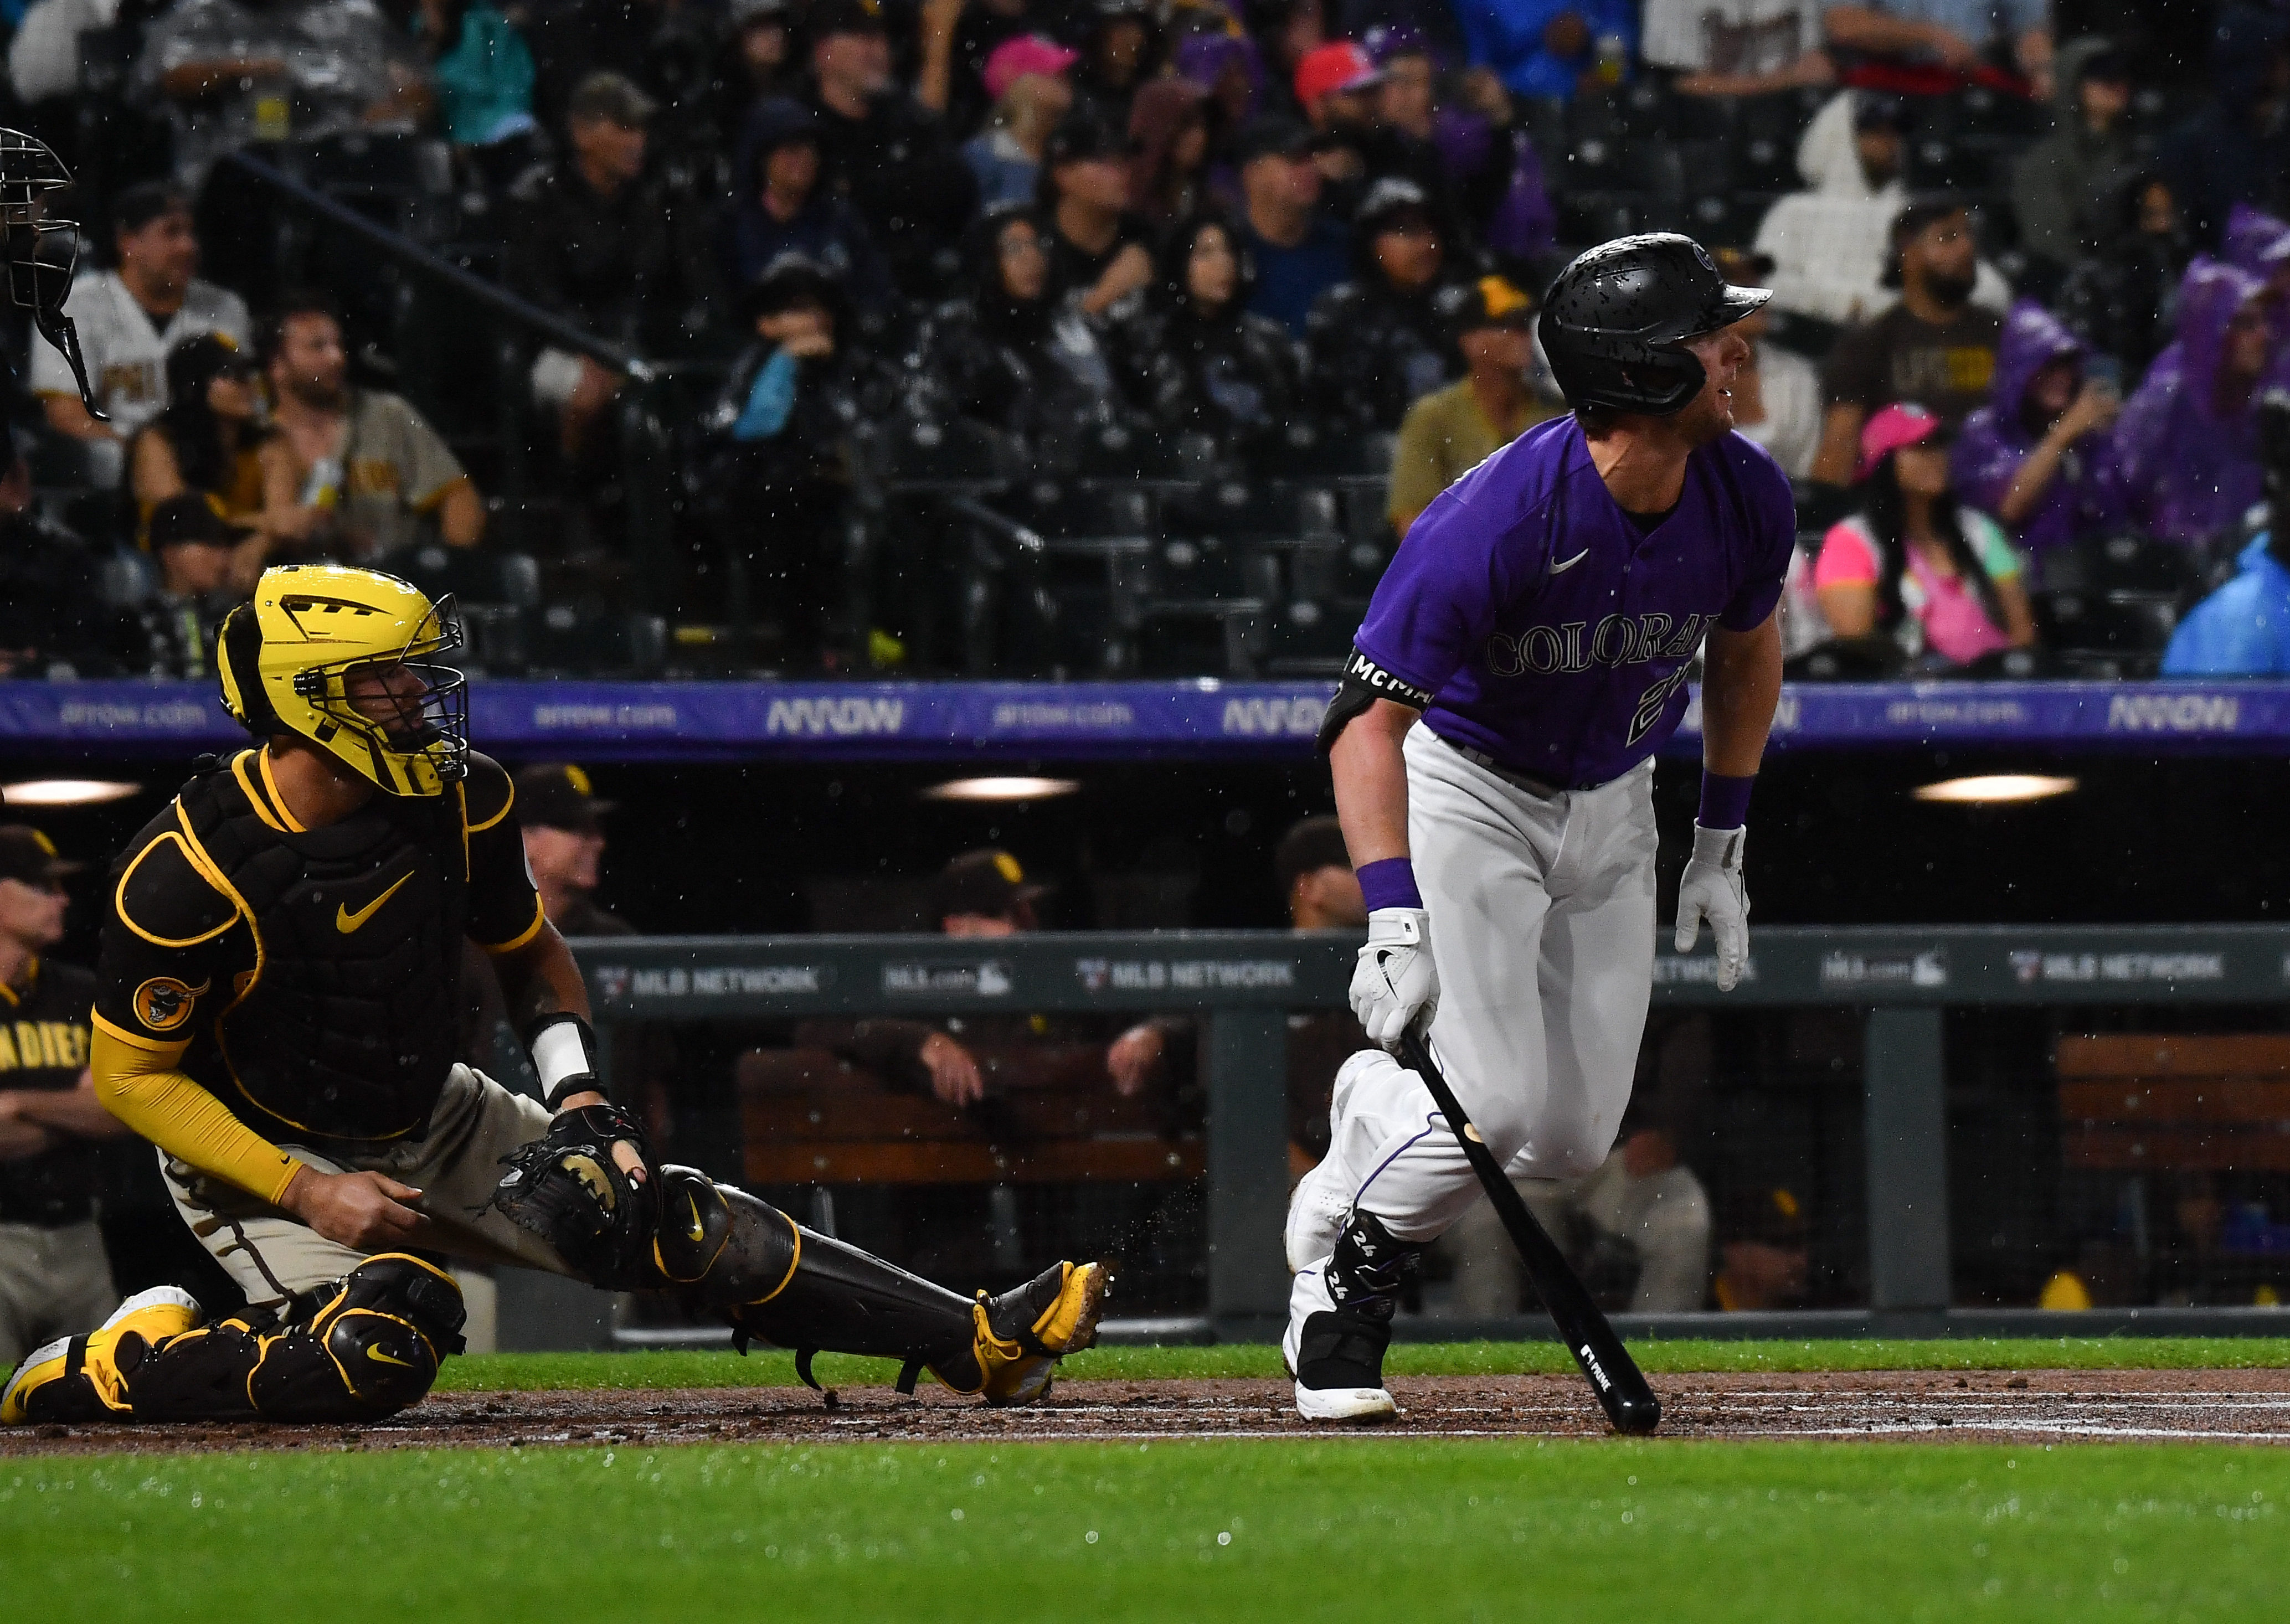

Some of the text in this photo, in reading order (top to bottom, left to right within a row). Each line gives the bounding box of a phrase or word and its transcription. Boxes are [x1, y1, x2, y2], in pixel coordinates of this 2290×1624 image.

[1485, 612, 1721, 677] COLORA
[1223, 699, 1326, 734] ARRO
[1352, 1230, 1378, 1257] 24
[1328, 1271, 1350, 1300] 24
[1591, 1362, 1612, 1393] PRIME
